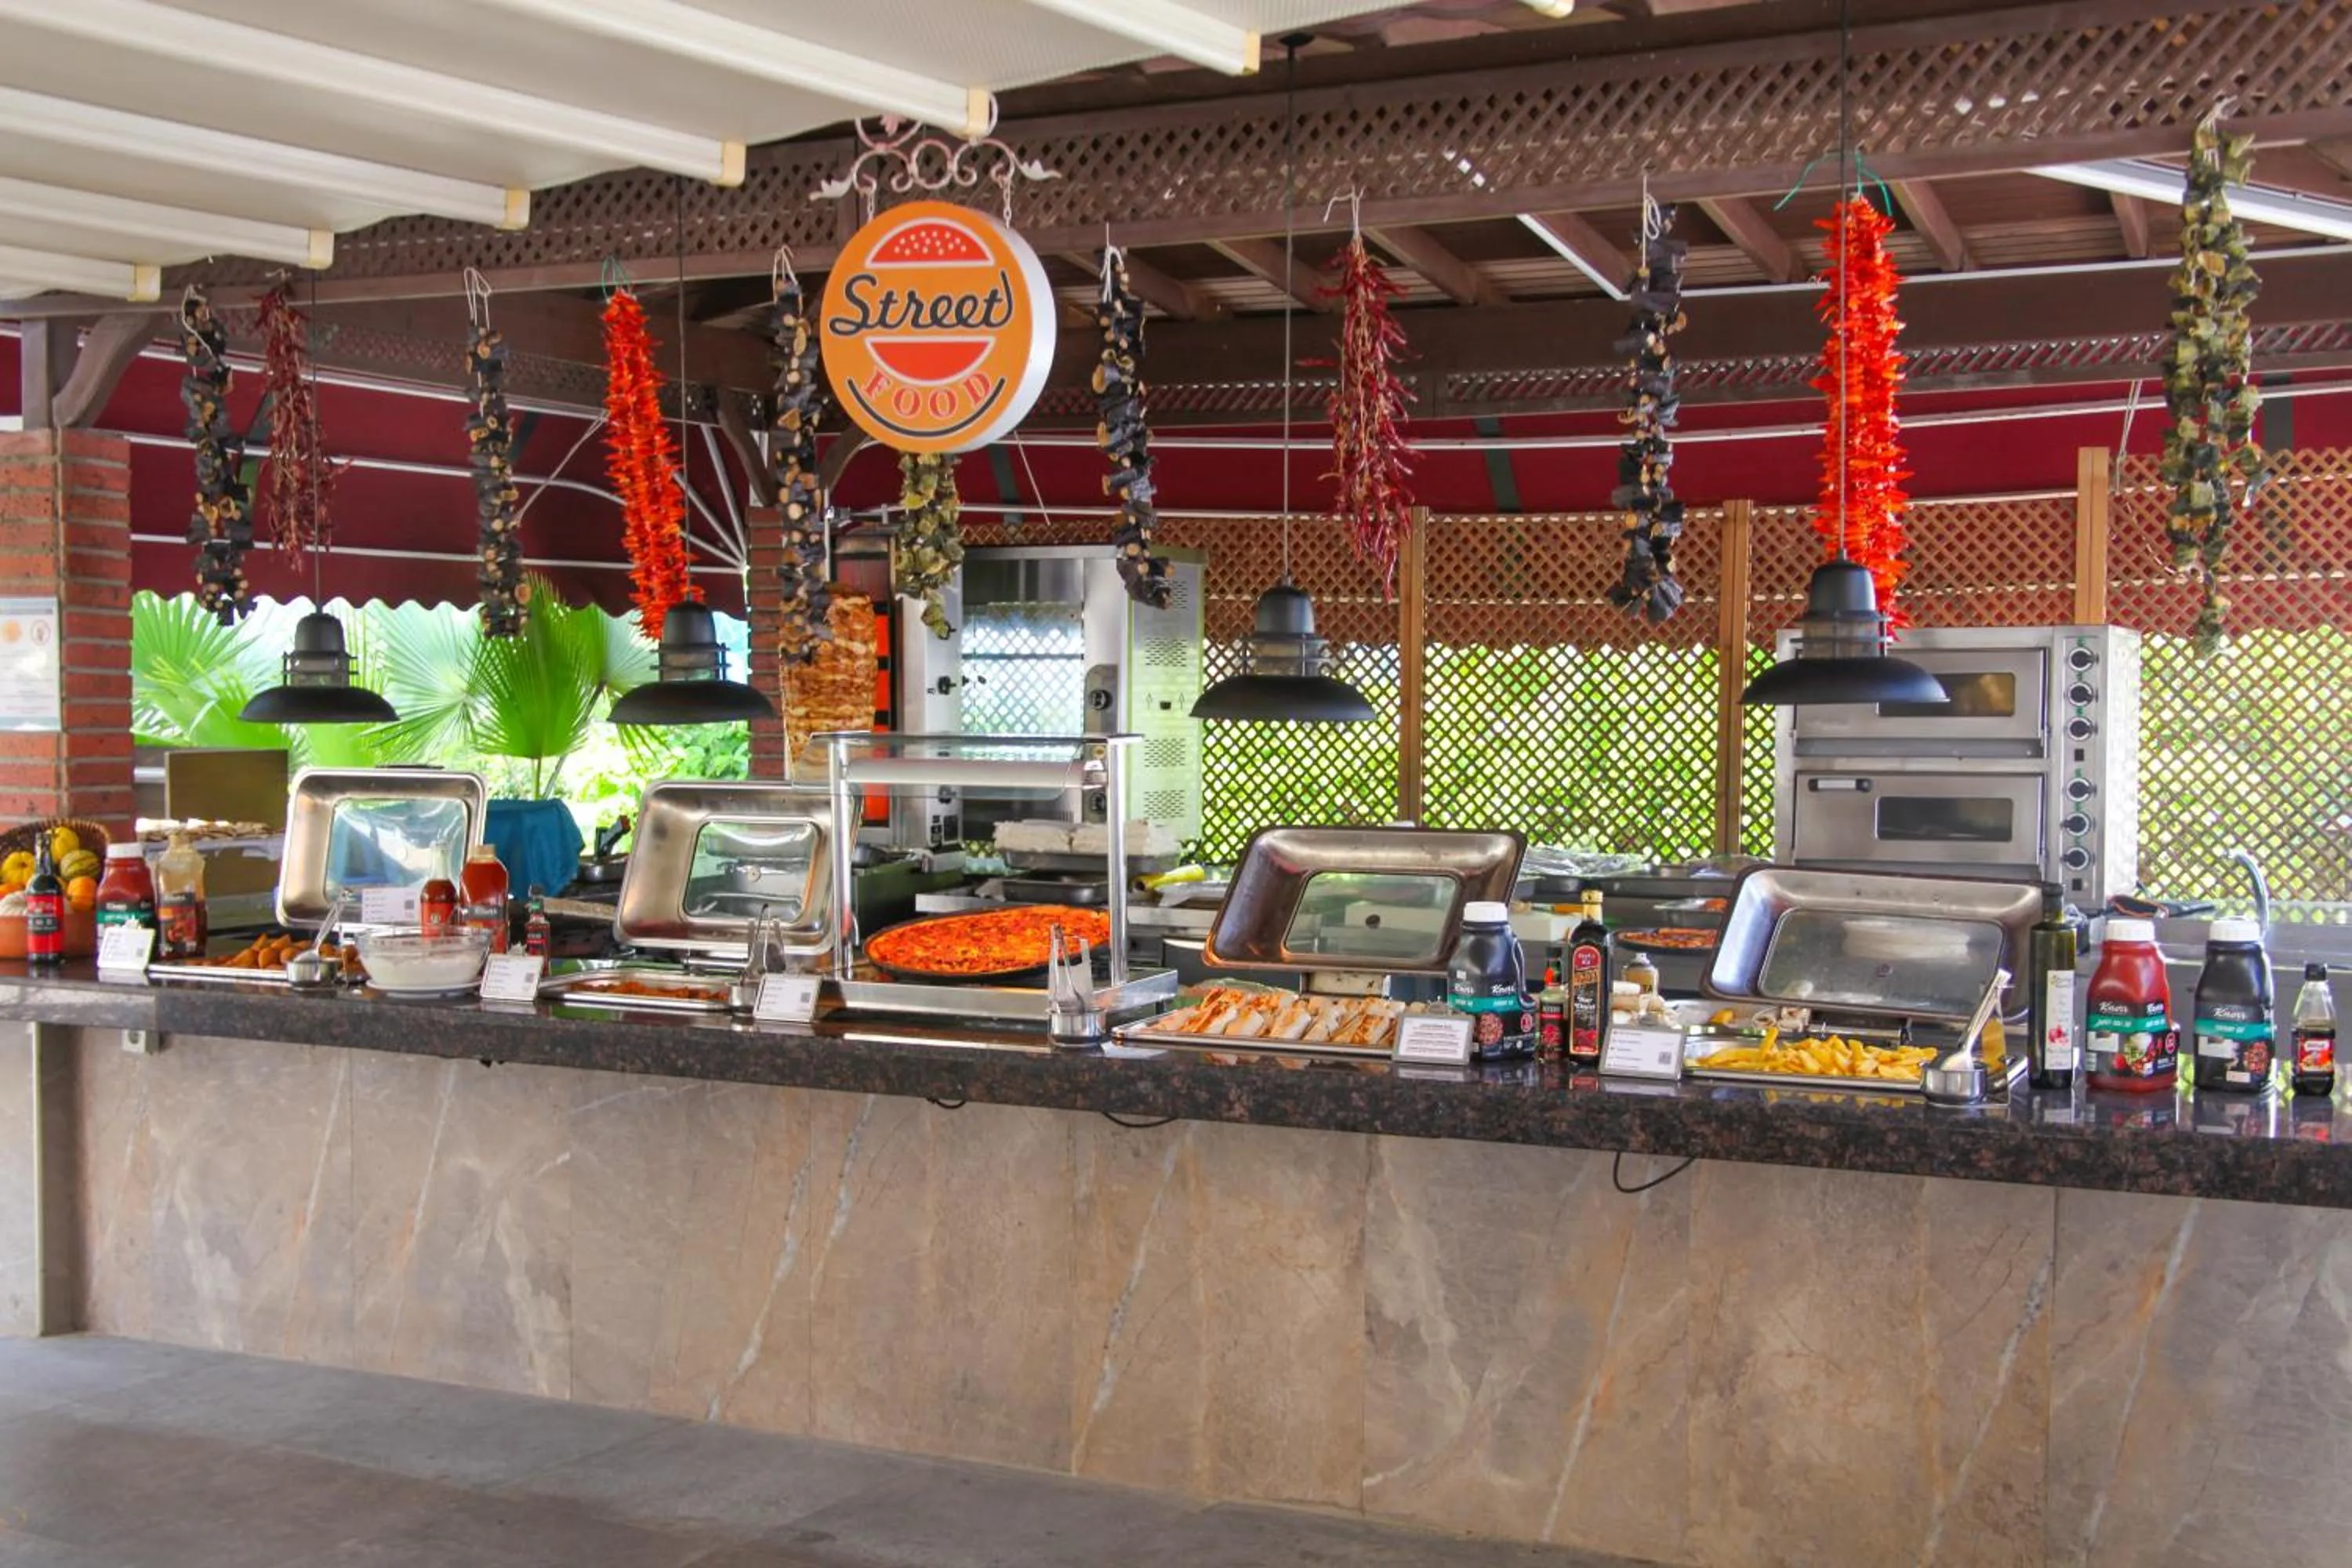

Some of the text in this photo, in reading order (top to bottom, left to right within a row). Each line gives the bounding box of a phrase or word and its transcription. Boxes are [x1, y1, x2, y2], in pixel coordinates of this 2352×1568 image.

[829, 270, 1014, 336] Street
[862, 367, 993, 418] FOOD
[2099, 1001, 2129, 1014] Knorr
[2213, 1007, 2247, 1021] Knorr
